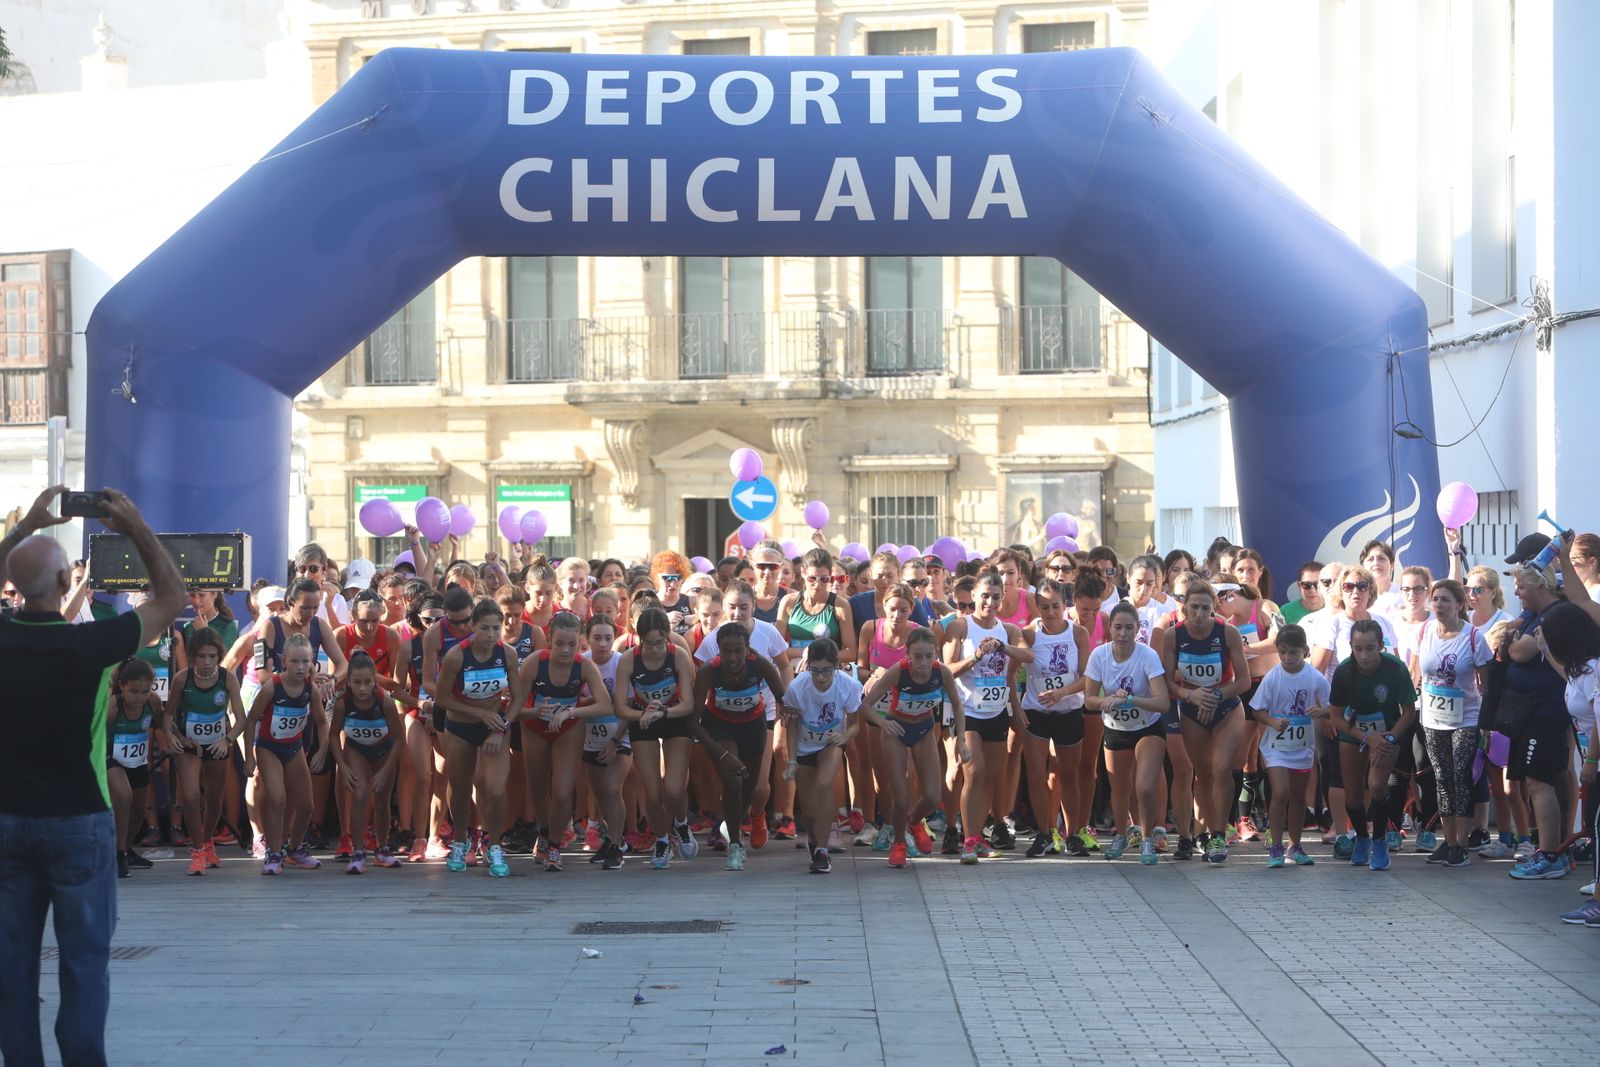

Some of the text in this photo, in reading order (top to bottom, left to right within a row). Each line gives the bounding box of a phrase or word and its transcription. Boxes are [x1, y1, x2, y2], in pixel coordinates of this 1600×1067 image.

[507, 68, 1023, 126] DEPORTES
[499, 154, 1029, 223] CHICLANA
[213, 546, 234, 576] 0
[1186, 664, 1215, 677] 100
[471, 680, 500, 694] 273
[1045, 676, 1064, 691] 83
[643, 686, 671, 701] 165
[724, 696, 753, 706] 162
[982, 686, 1007, 701] 297
[1429, 694, 1455, 712] 721
[279, 715, 306, 730] 397
[1112, 708, 1140, 722] 250
[193, 721, 222, 736] 696
[352, 728, 382, 739] 396
[591, 724, 608, 738] 49
[807, 729, 833, 742] 17
[121, 742, 146, 758] 120
